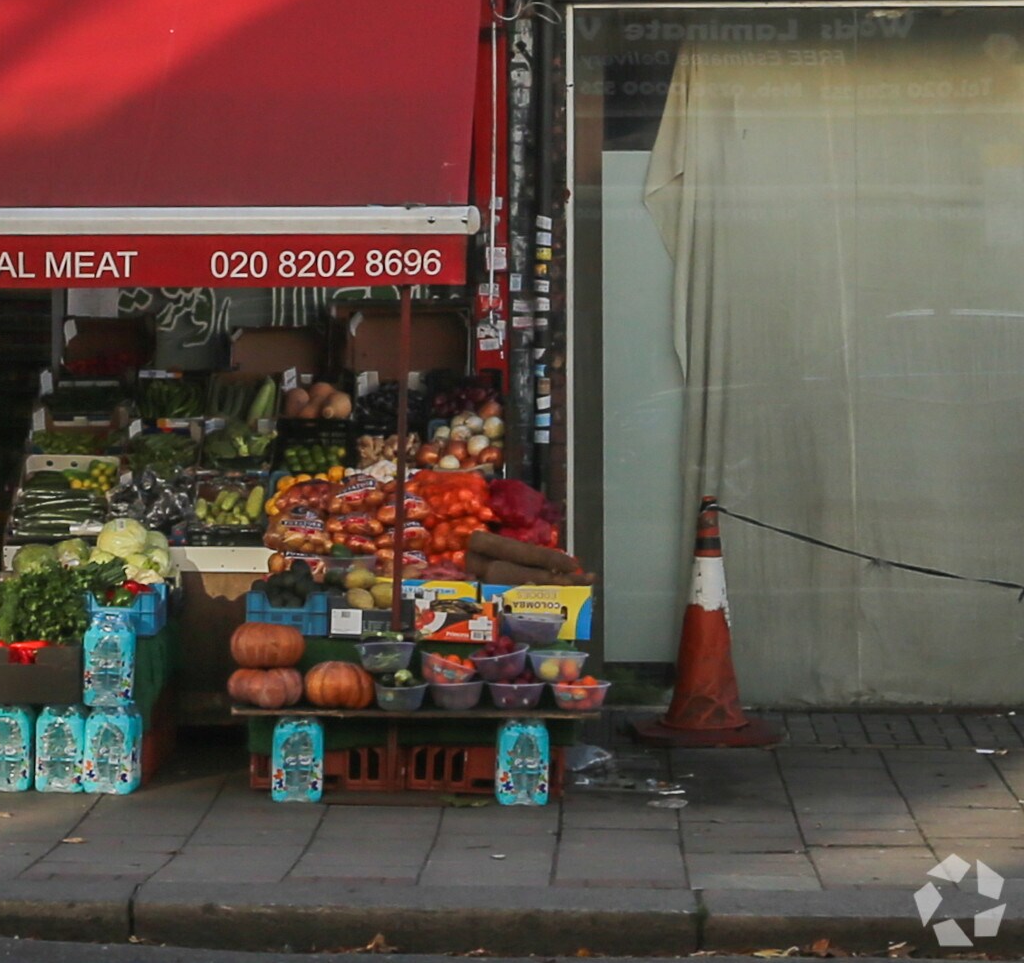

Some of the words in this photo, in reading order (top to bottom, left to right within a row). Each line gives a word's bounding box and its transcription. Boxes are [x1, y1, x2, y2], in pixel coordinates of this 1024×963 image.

[45, 251, 138, 279] MEAT
[210, 250, 268, 279] 020
[278, 250, 354, 279] 8202
[365, 249, 442, 278] 8696
[512, 601, 561, 609] COLOMBA
